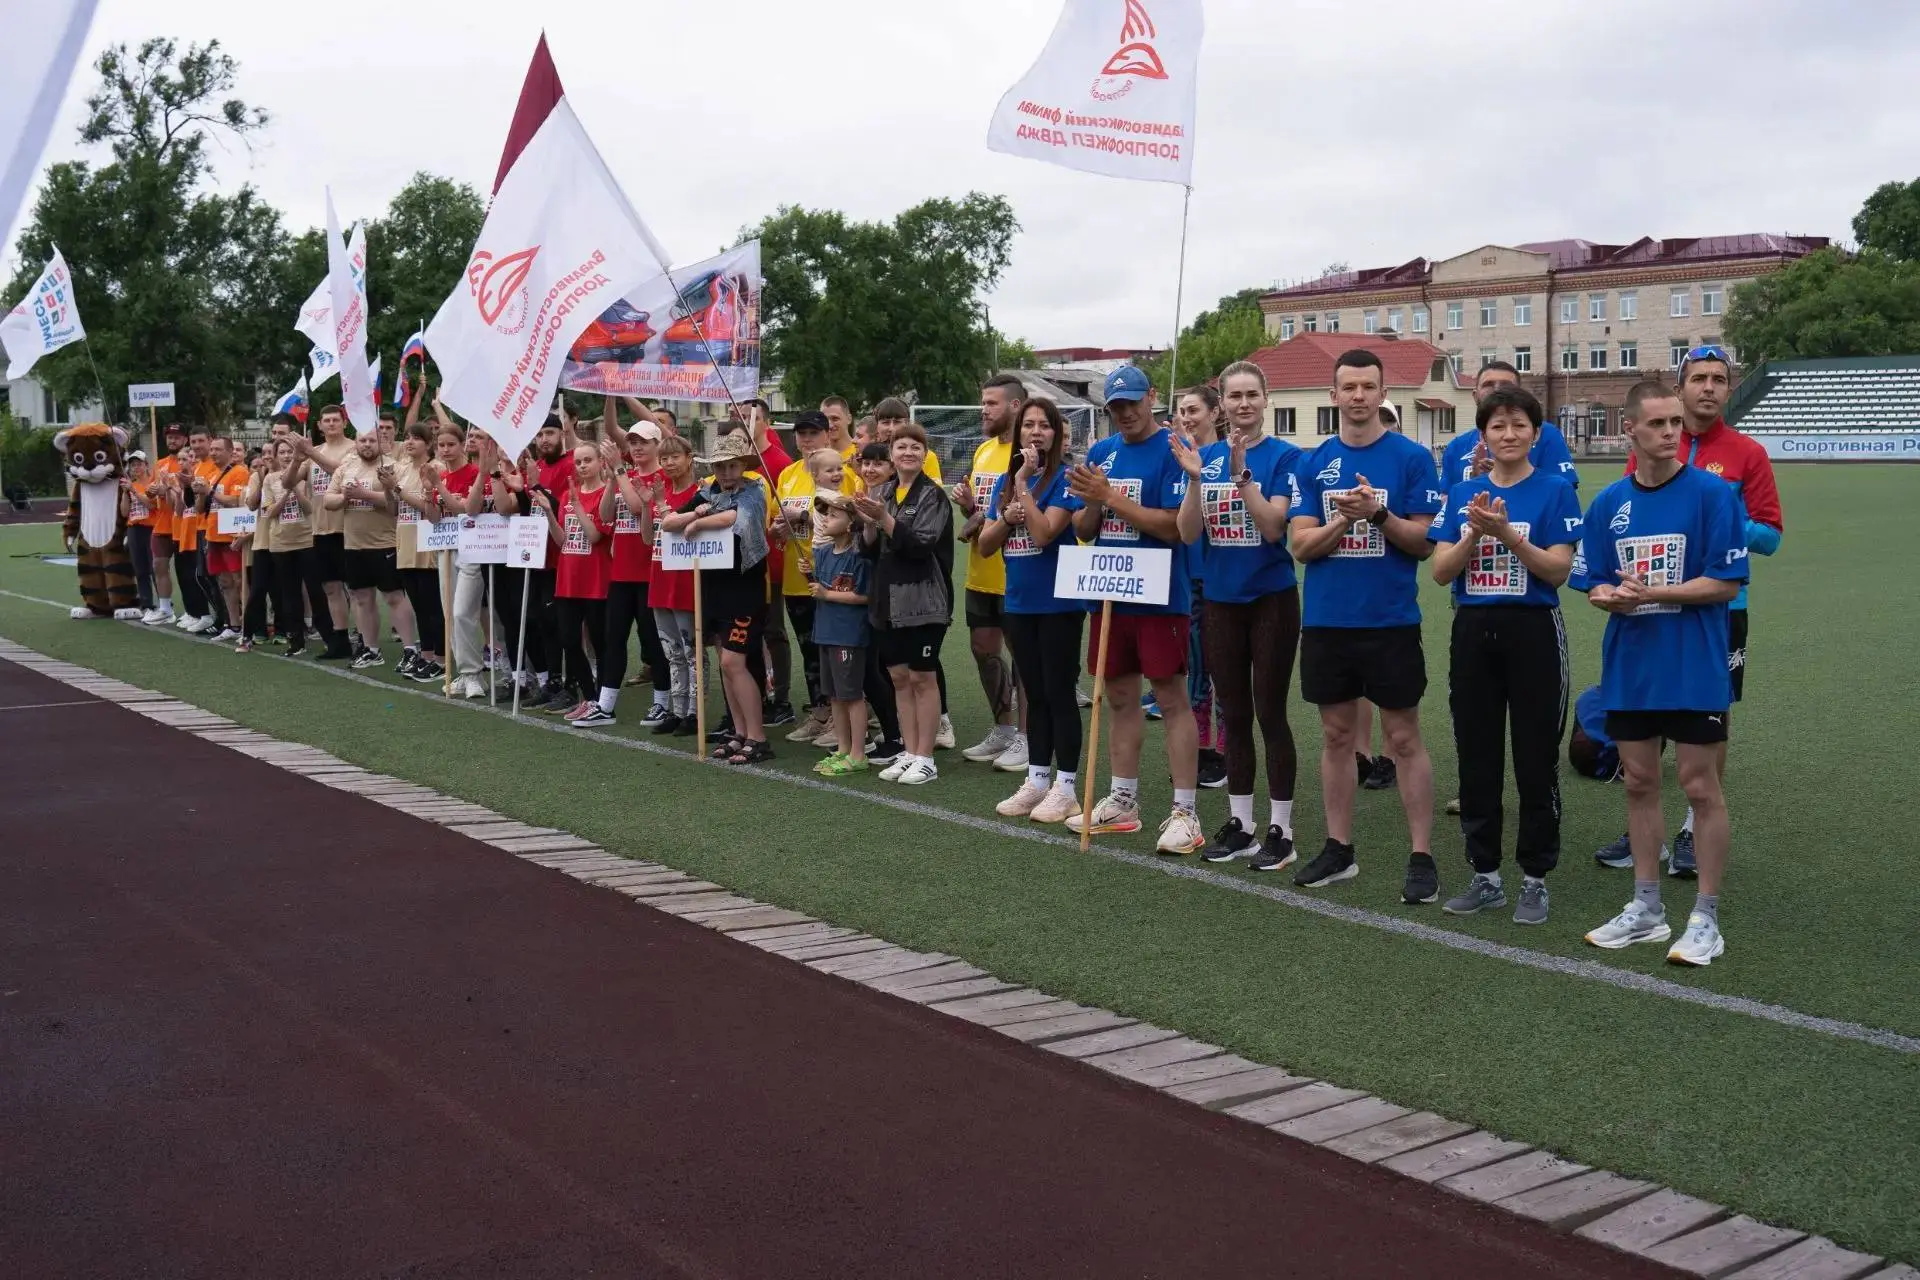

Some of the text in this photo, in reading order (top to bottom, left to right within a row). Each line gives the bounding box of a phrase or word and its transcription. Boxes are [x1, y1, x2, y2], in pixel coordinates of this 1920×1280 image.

[1781, 439, 1895, 454] Спортивная
[233, 515, 256, 527] ДРАЙВ
[1211, 526, 1244, 539] МЫ
[427, 534, 459, 546] СКОРОС
[1006, 539, 1027, 550] МЫ
[670, 541, 724, 558] ЛЮДИ ДЕЛА
[1091, 554, 1134, 572] ГОТОВ
[1077, 574, 1145, 598] К ПОБЕДЕ
[1471, 573, 1508, 587] МЫ
